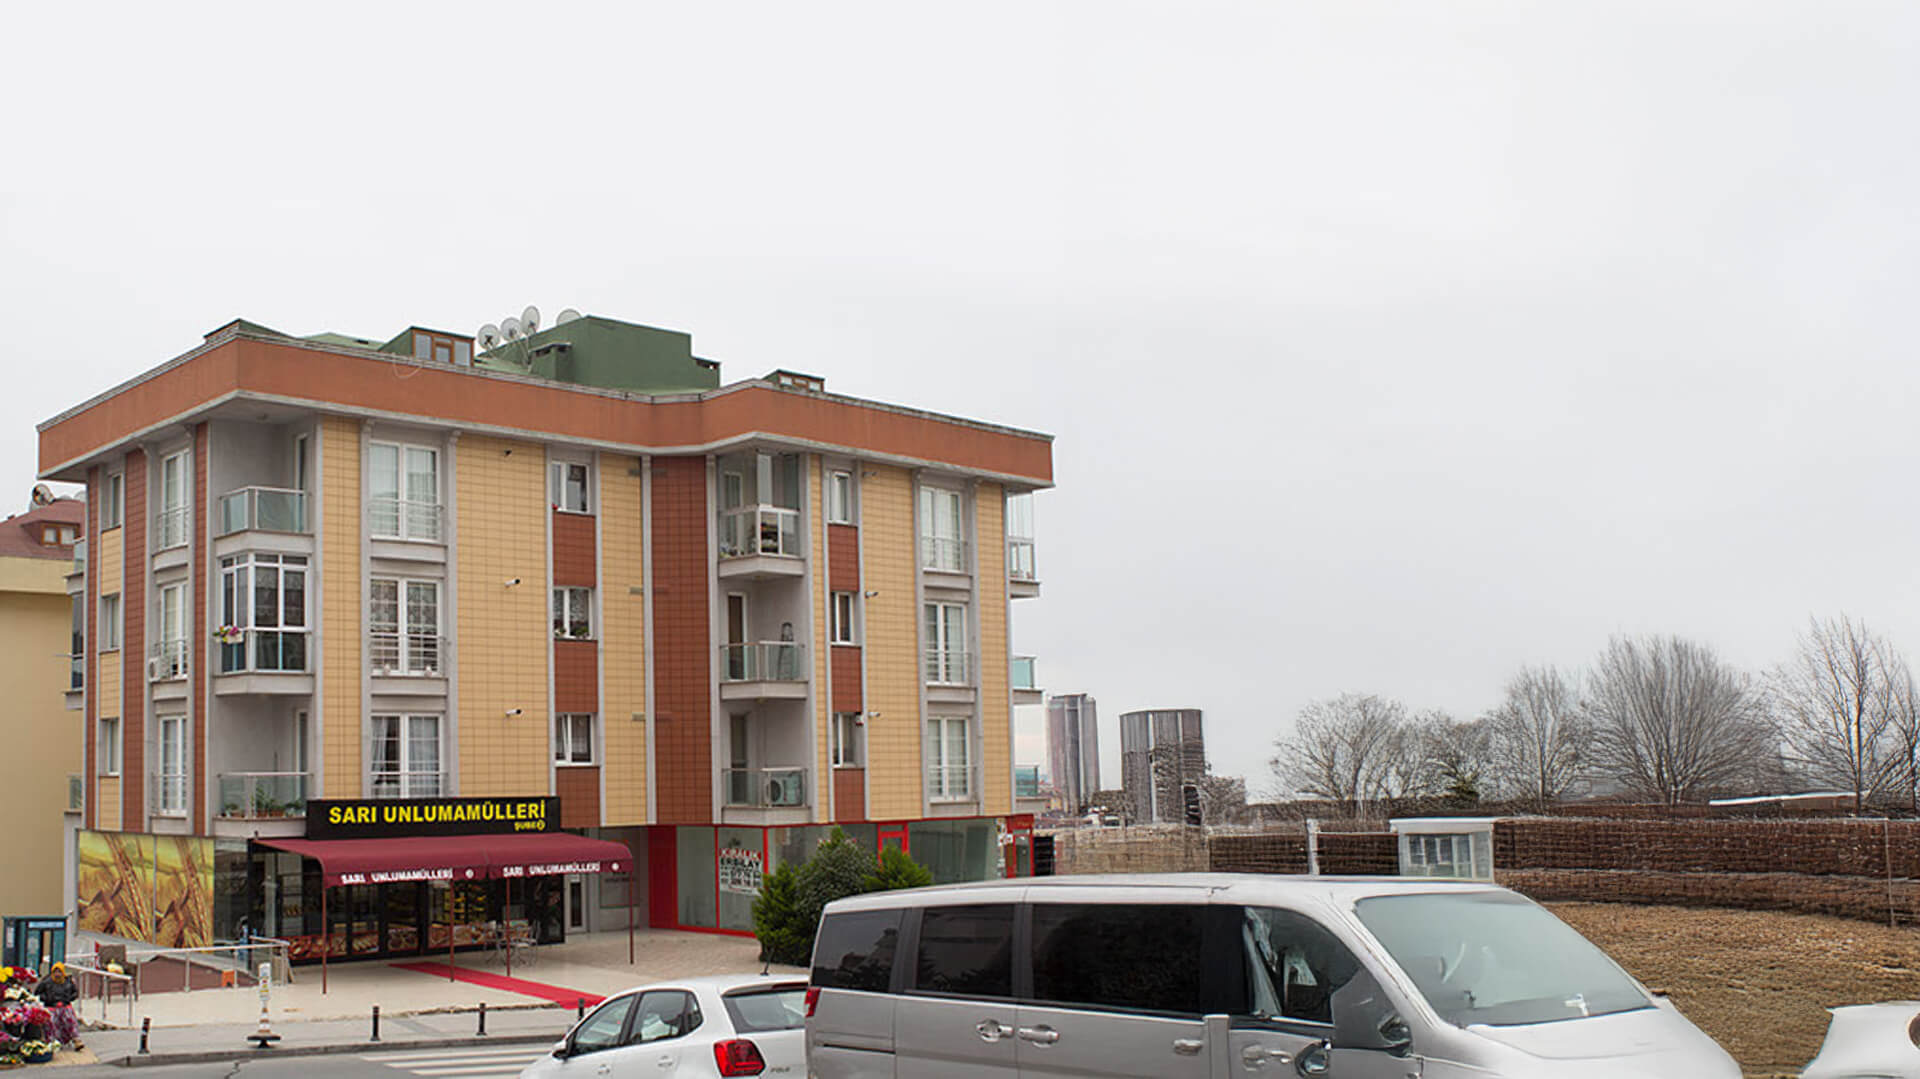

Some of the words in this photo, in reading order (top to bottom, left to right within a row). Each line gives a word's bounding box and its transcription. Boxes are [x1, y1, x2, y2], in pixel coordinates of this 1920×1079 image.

[328, 805, 377, 824] SARI
[383, 799, 546, 823] UNLUMAMÜLLERİ
[503, 866, 523, 878] SARI
[341, 873, 366, 884] SARI
